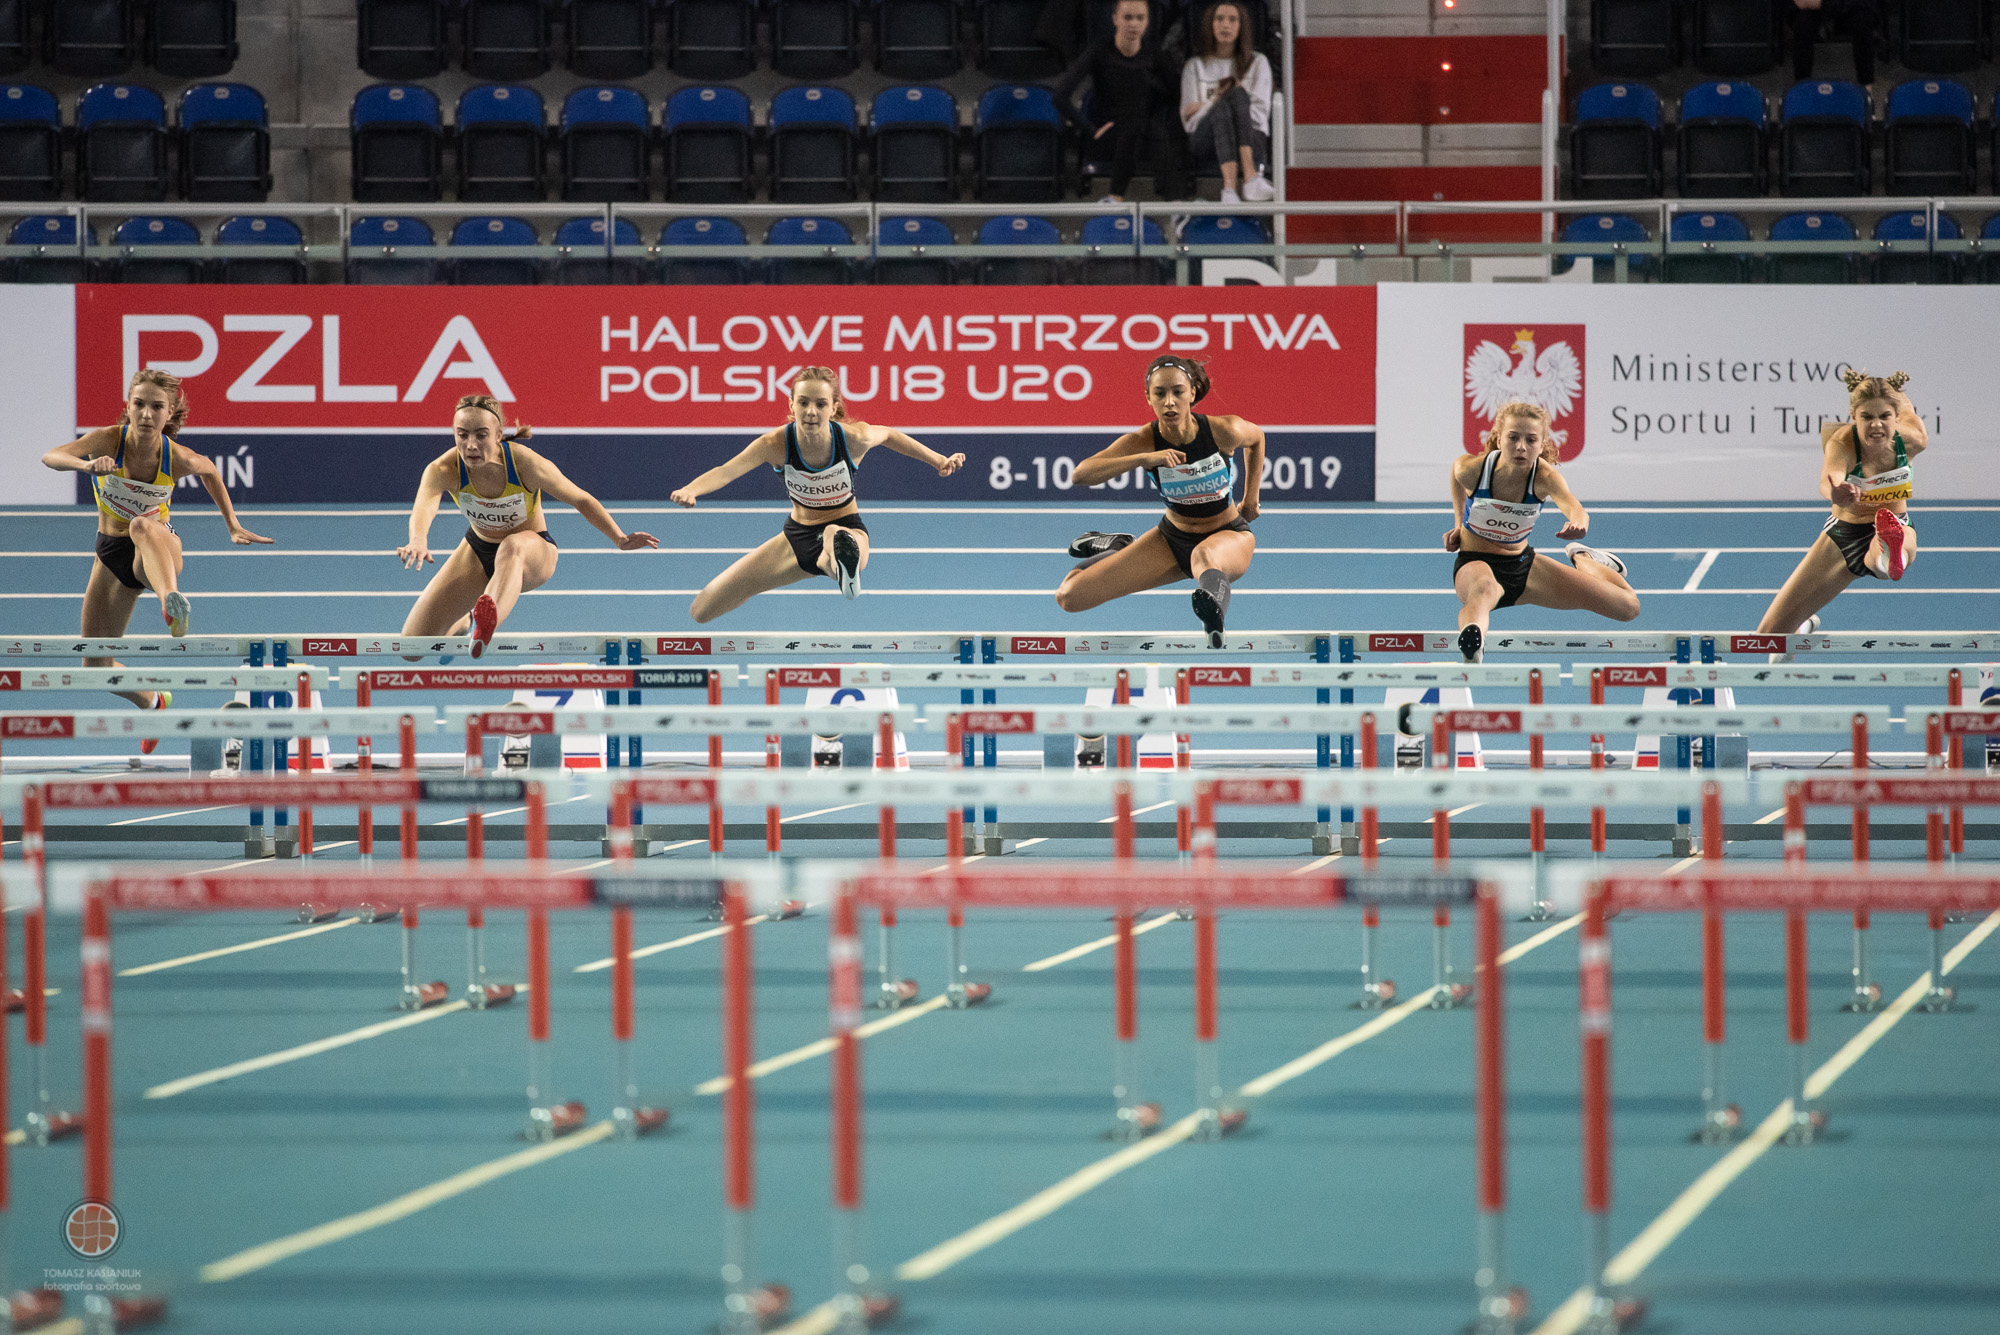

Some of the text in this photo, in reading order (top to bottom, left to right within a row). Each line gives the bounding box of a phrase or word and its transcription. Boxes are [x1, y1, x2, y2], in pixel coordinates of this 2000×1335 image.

[601, 314, 1341, 352] HALOWE MISTRZOSTWA
[122, 314, 517, 403] PZLA
[1612, 353, 1852, 383] Ministerstwo
[600, 365, 1093, 402] POLSK U18 U20
[1611, 405, 1731, 441] Sportu
[1750, 406, 1756, 434] i
[988, 455, 1074, 490] 8-10
[1260, 455, 1342, 490] 2019
[787, 479, 849, 495] ROŻEŃSKA
[1163, 474, 1228, 497] MAJEWSKA
[466, 509, 519, 524] NAGIĘĆ
[1486, 518, 1519, 531] OKO
[309, 642, 349, 652] PZLA
[663, 641, 703, 651] PZLA
[1017, 640, 1058, 651] PZLA
[1375, 638, 1416, 648] PZLA
[1737, 639, 1778, 649] PZLA
[377, 673, 626, 686] PZLA HALOWE MISTRZOSTWA POLSKI
[639, 671, 703, 683] TORUŃ 2019
[785, 671, 832, 683] PZLA
[1195, 669, 1242, 682] PZLA
[1610, 670, 1657, 682] PZLA
